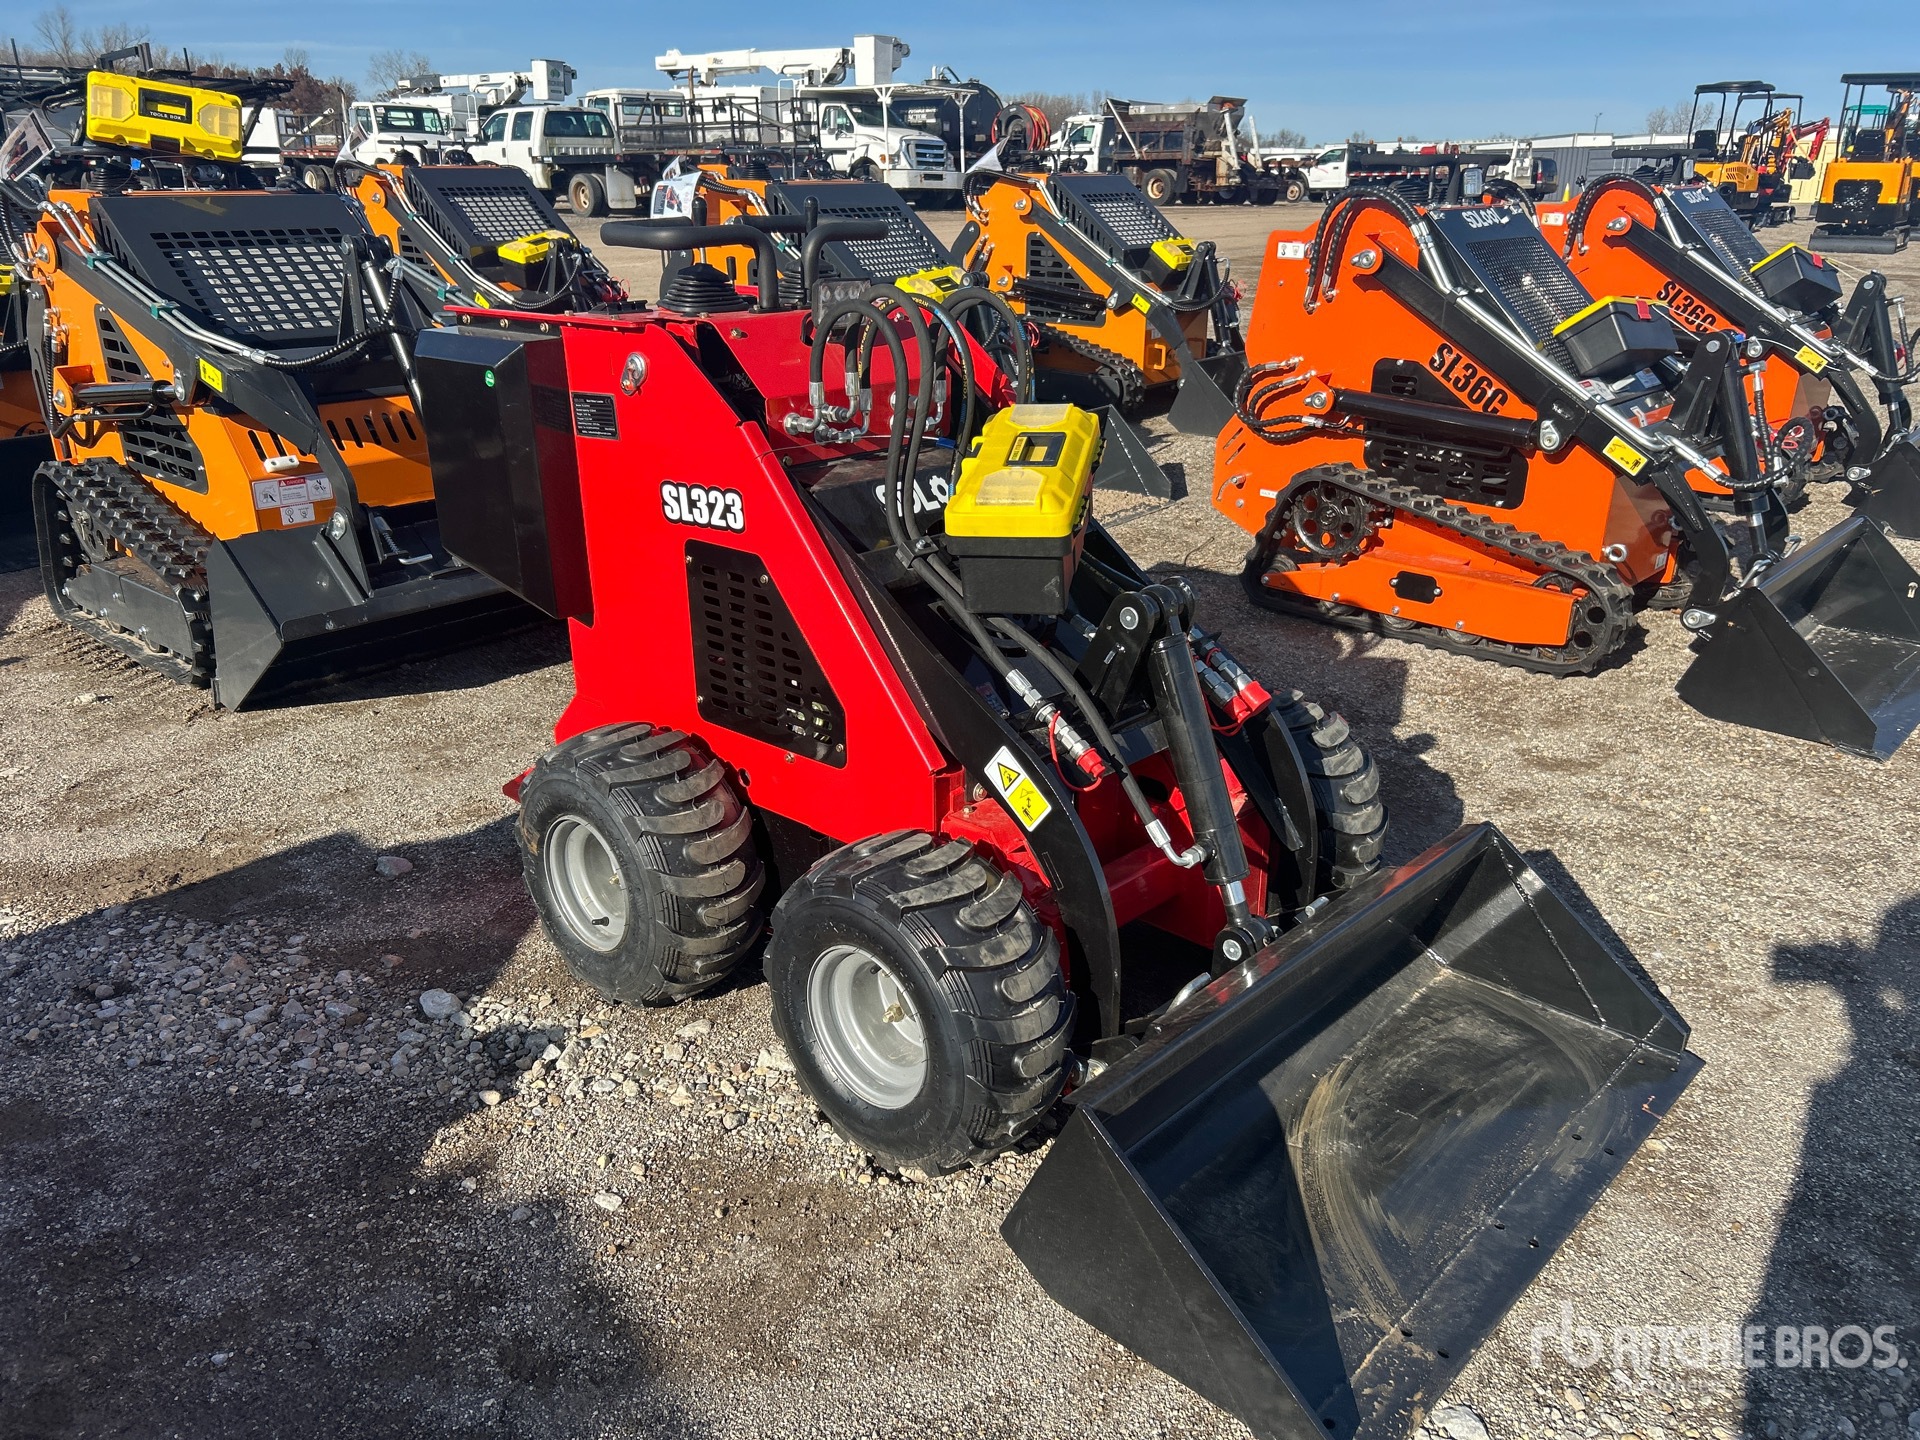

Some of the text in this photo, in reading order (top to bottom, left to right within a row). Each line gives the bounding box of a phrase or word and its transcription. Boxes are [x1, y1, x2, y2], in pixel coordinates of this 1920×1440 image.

[1657, 280, 1717, 333] SL36C
[1429, 342, 1509, 415] SL36C
[661, 483, 745, 531] SL323
